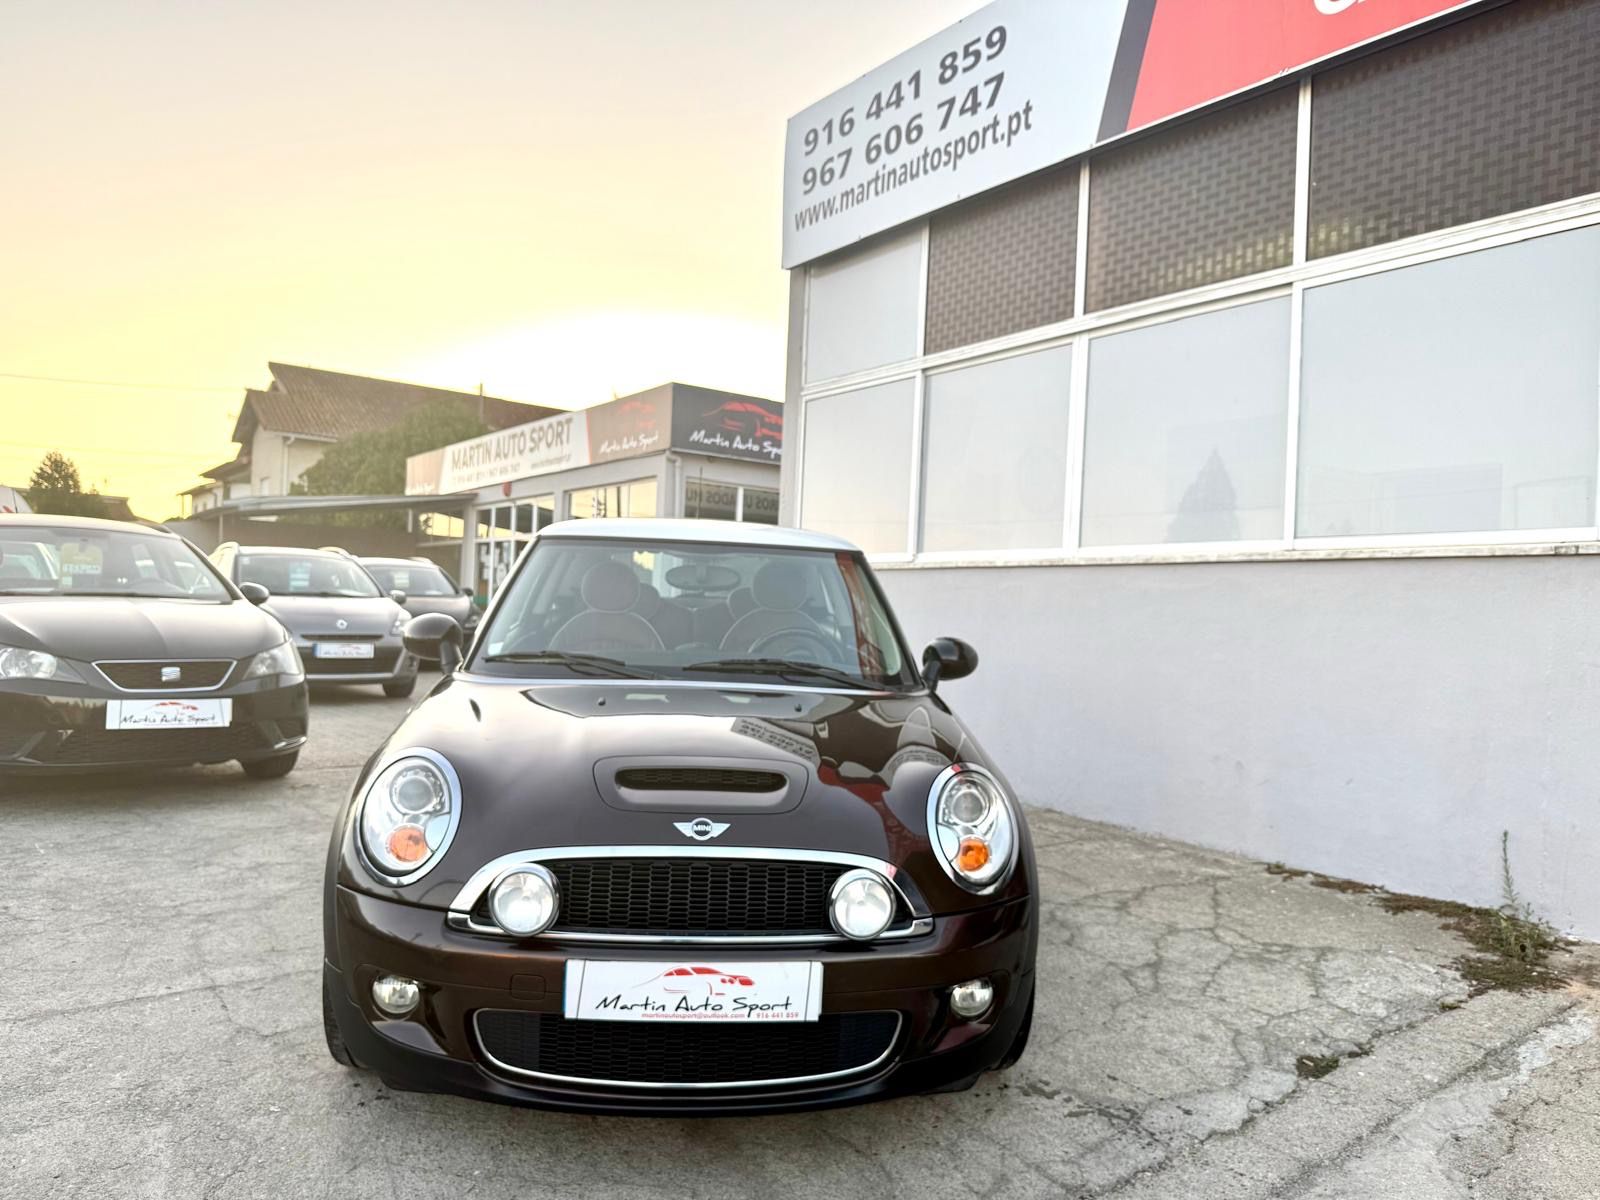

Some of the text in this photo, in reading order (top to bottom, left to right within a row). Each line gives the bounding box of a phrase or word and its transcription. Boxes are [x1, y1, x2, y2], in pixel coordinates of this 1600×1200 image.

[802, 72, 1005, 195] 967 606 747
[804, 25, 1007, 156] 916 441 859
[794, 99, 1033, 232] www.martinautosport.pt
[451, 440, 492, 472] MARTIN
[495, 430, 526, 462] AUTO
[529, 418, 573, 453] SPORT
[689, 429, 729, 449] Martin
[732, 435, 760, 452] Auto
[596, 994, 793, 1018] Martin Auto Sport
